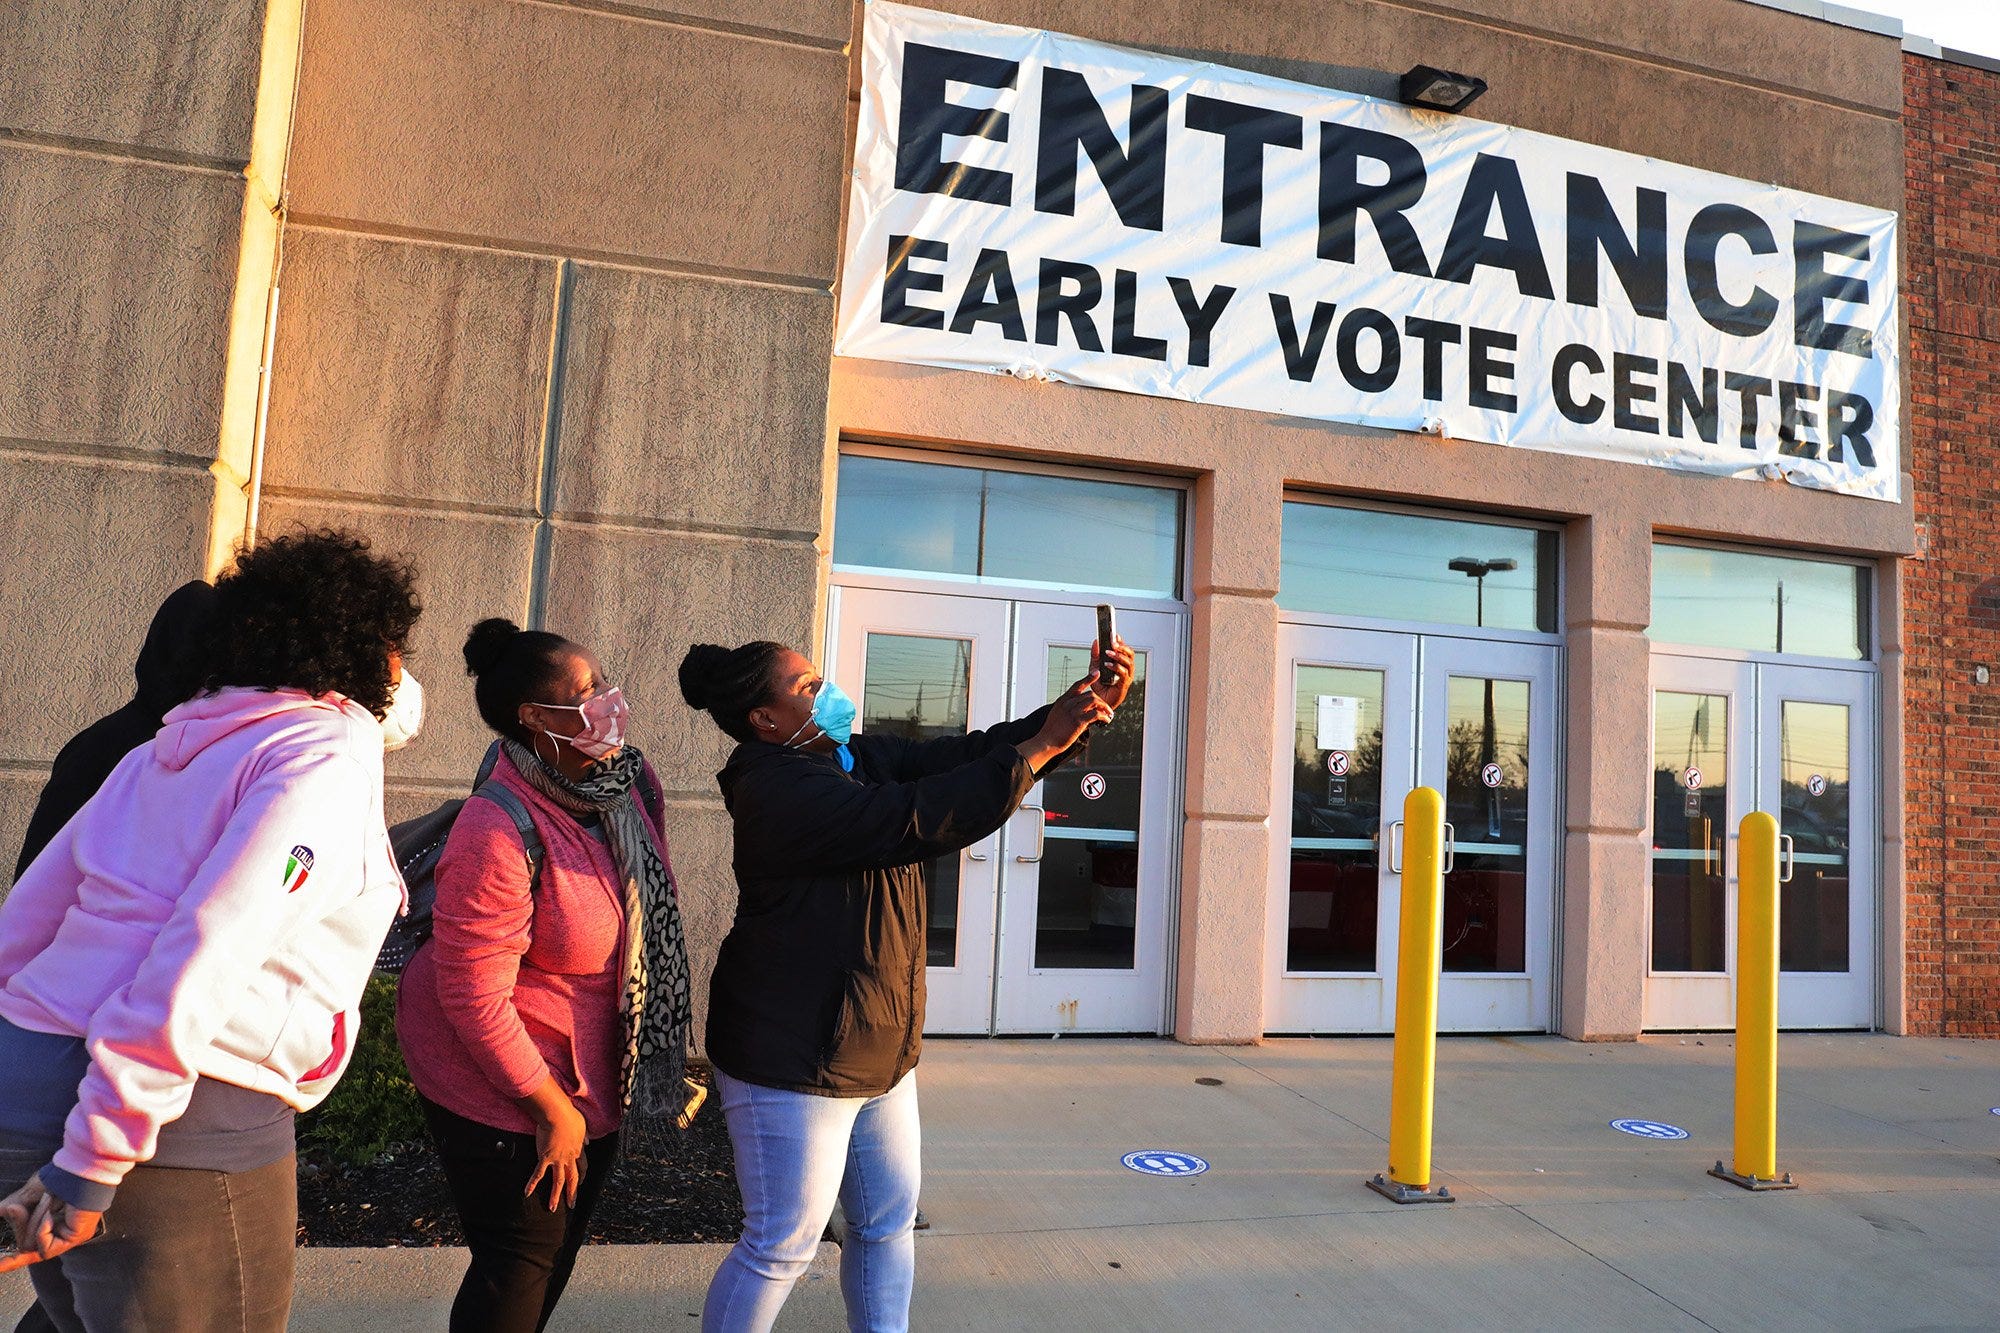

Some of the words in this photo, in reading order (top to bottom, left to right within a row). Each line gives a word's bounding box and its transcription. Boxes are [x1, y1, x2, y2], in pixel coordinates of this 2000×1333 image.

[894, 41, 1874, 359] ENTRANCE
[880, 235, 1236, 367] EARLY
[1269, 293, 1518, 414] VOTE
[1552, 343, 1877, 468] CENTER
[293, 846, 314, 868] ITALIA
